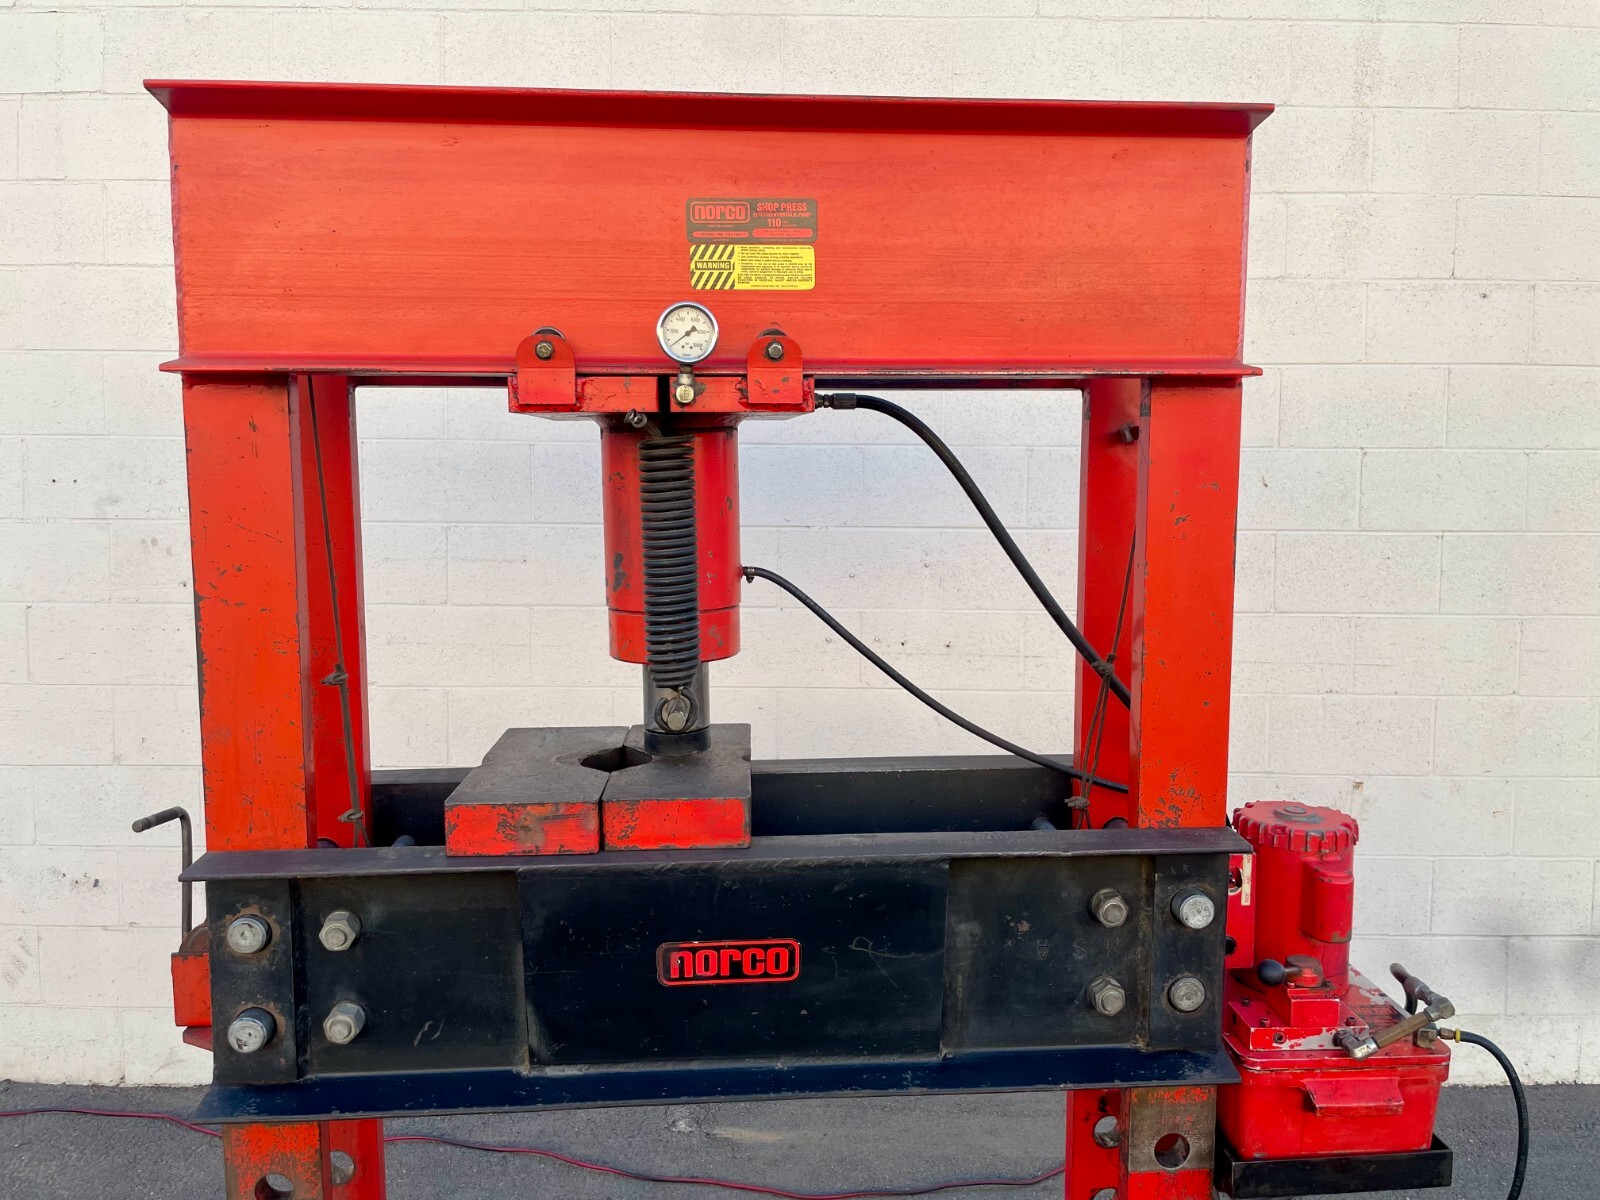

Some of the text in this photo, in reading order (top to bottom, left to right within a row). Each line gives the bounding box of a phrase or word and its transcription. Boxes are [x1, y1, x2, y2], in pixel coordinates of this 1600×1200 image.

[756, 202, 807, 212] SHOP PRESS
[694, 205, 746, 220] norco
[767, 218, 782, 228] 110
[696, 261, 730, 270] WARNING
[670, 947, 789, 979] norco
